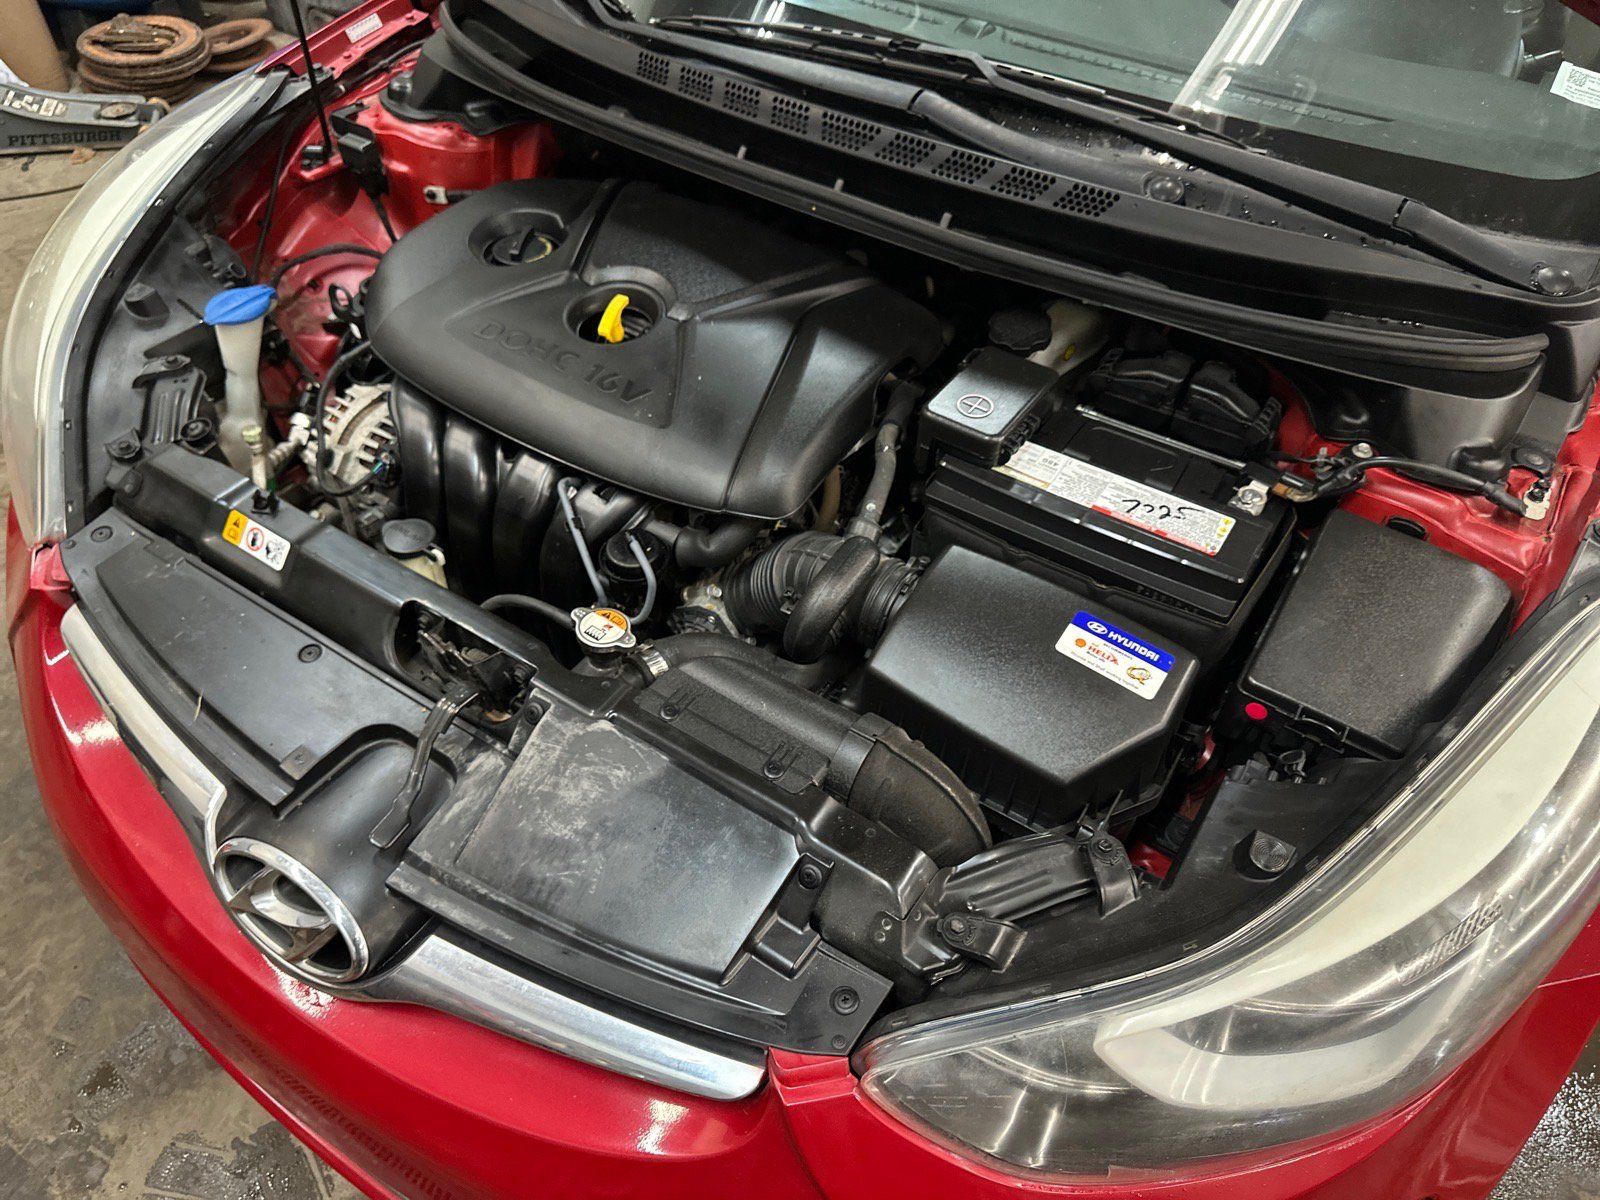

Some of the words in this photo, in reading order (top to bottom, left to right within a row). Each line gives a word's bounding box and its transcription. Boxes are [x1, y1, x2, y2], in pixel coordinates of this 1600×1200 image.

[8, 130, 122, 147] PITTSBURGH
[472, 321, 580, 373] DOHC
[584, 363, 654, 403] 16V
[1087, 645, 1119, 666] HELIX
[1108, 631, 1160, 661] HYUNDAI
